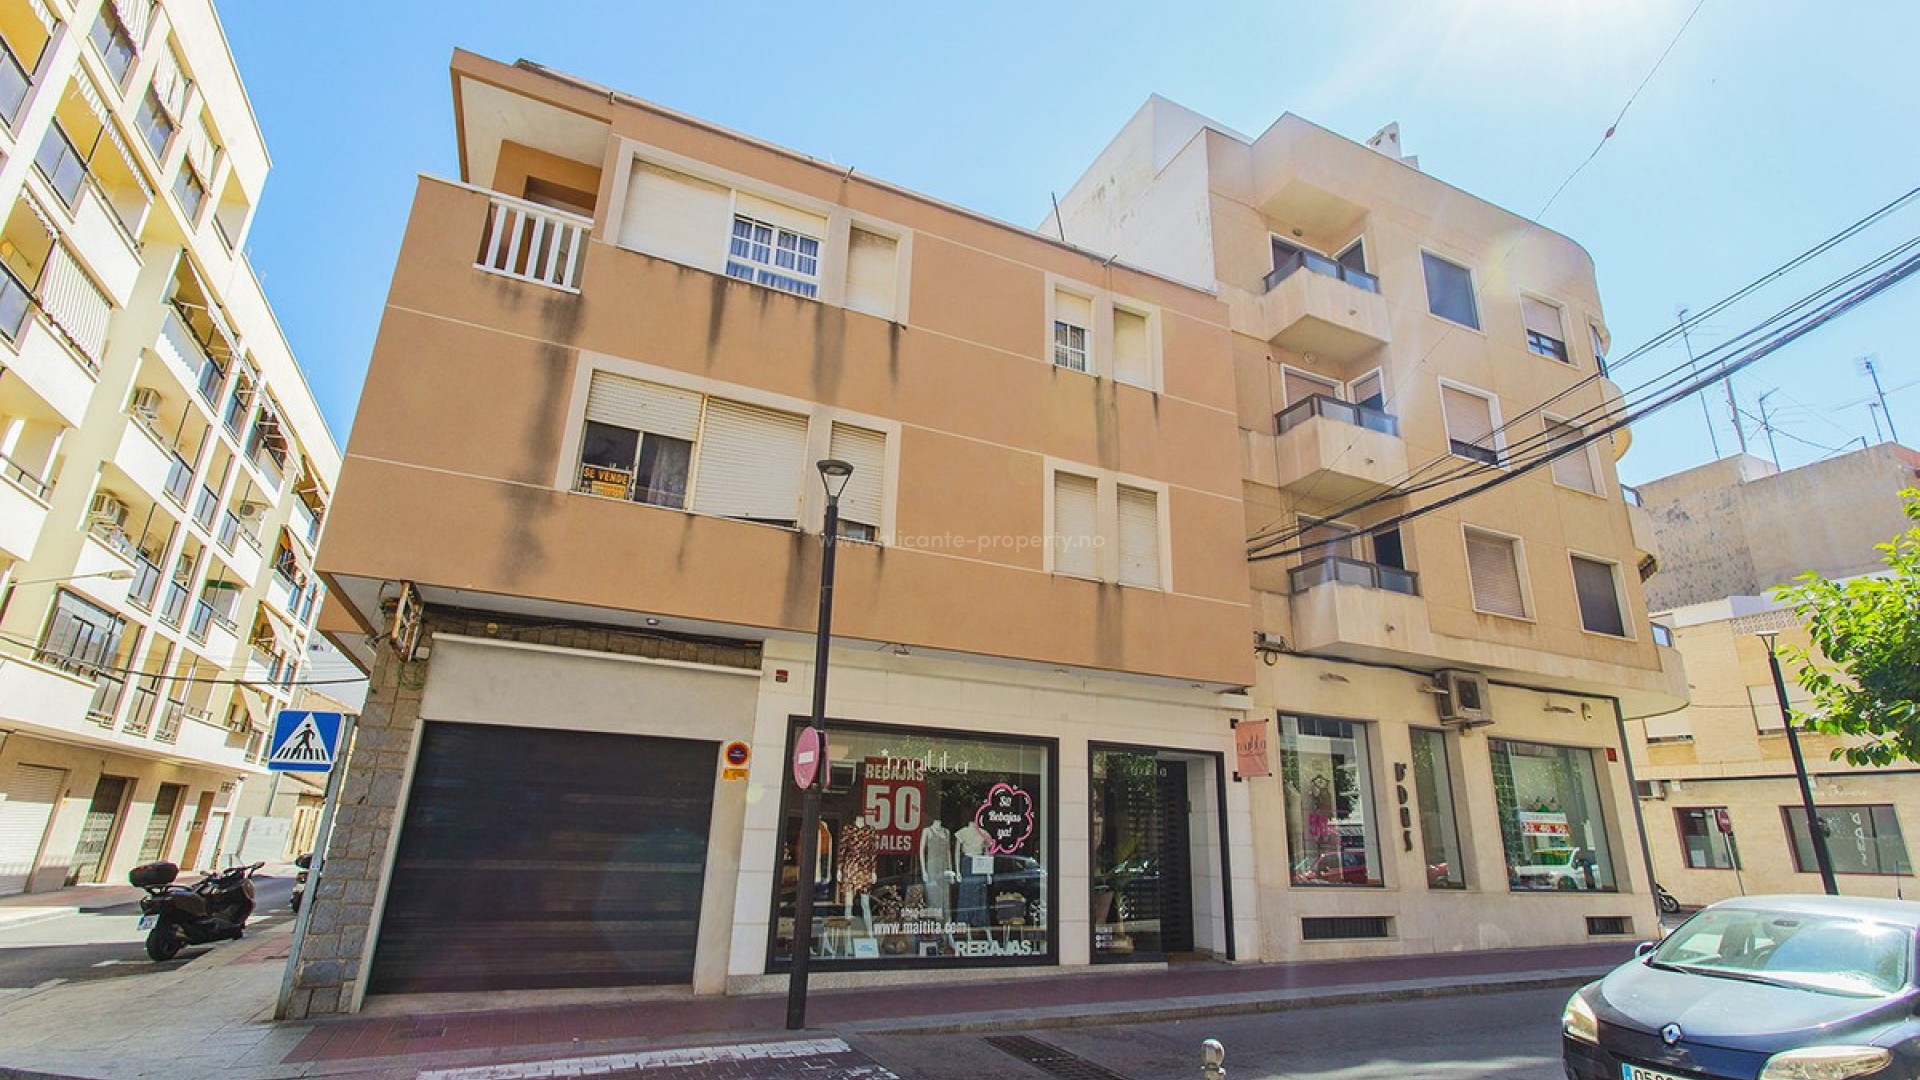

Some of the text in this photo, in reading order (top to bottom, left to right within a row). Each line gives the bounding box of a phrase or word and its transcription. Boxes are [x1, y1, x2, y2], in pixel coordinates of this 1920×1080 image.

[583, 467, 629, 485] SE VENDE
[865, 763, 925, 781] REBAJAS
[873, 919, 967, 935] www.maitita.com
